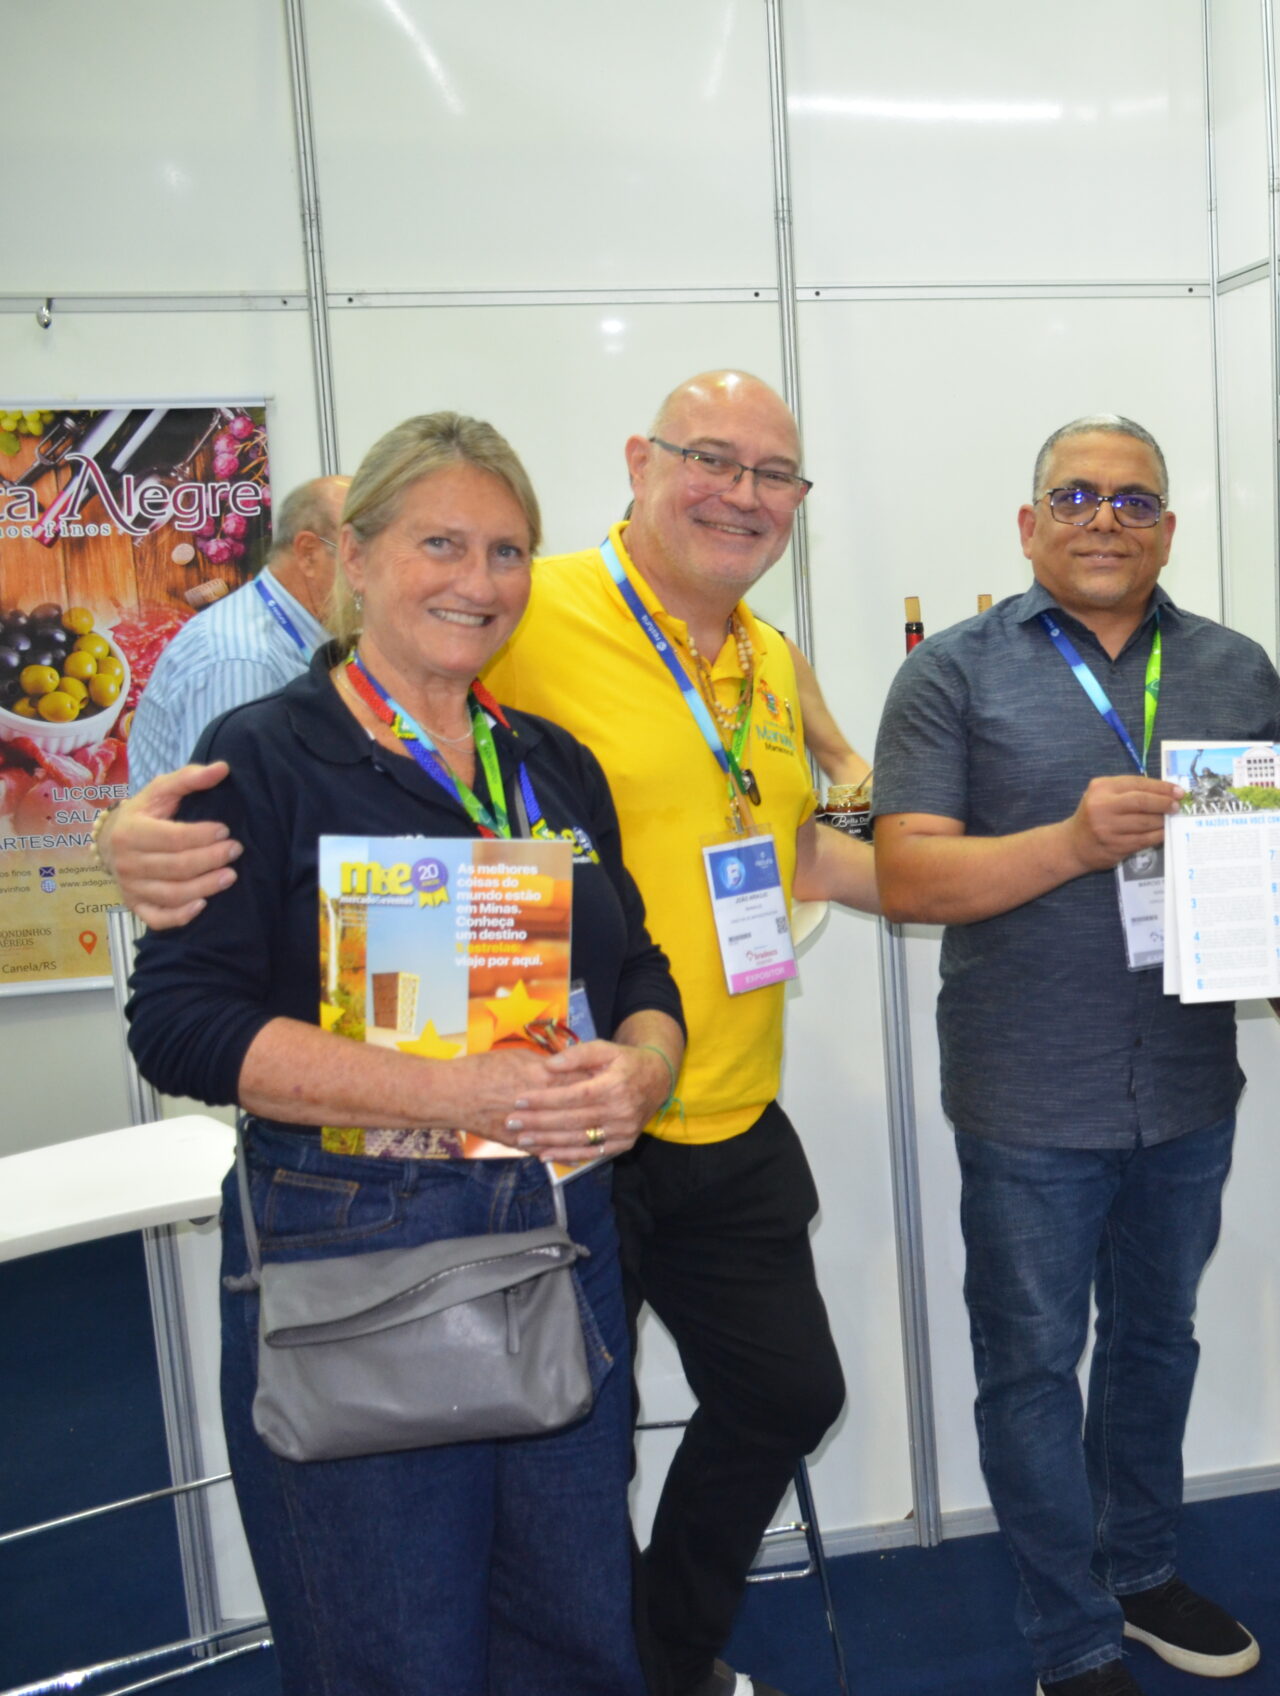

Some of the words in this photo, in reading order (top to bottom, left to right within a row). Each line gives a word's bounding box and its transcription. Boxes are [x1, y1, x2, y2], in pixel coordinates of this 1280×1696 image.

[59, 453, 262, 536] Alegre
[44, 521, 111, 538] finos
[418, 863, 439, 881] 20
[457, 863, 475, 875] As
[477, 863, 538, 875] melhores
[456, 876, 499, 888] coisas
[502, 876, 519, 888] do
[456, 889, 501, 901] mundo
[505, 890, 542, 901] estão
[455, 905, 477, 914] em
[479, 903, 522, 914] Minas.
[455, 916, 515, 929] Conheça
[455, 930, 477, 941] um
[479, 929, 528, 941] destino
[2, 961, 57, 974] Canela/RS
[454, 955, 485, 967] viaje
[487, 957, 509, 968] por
[512, 956, 543, 968] aqui.
